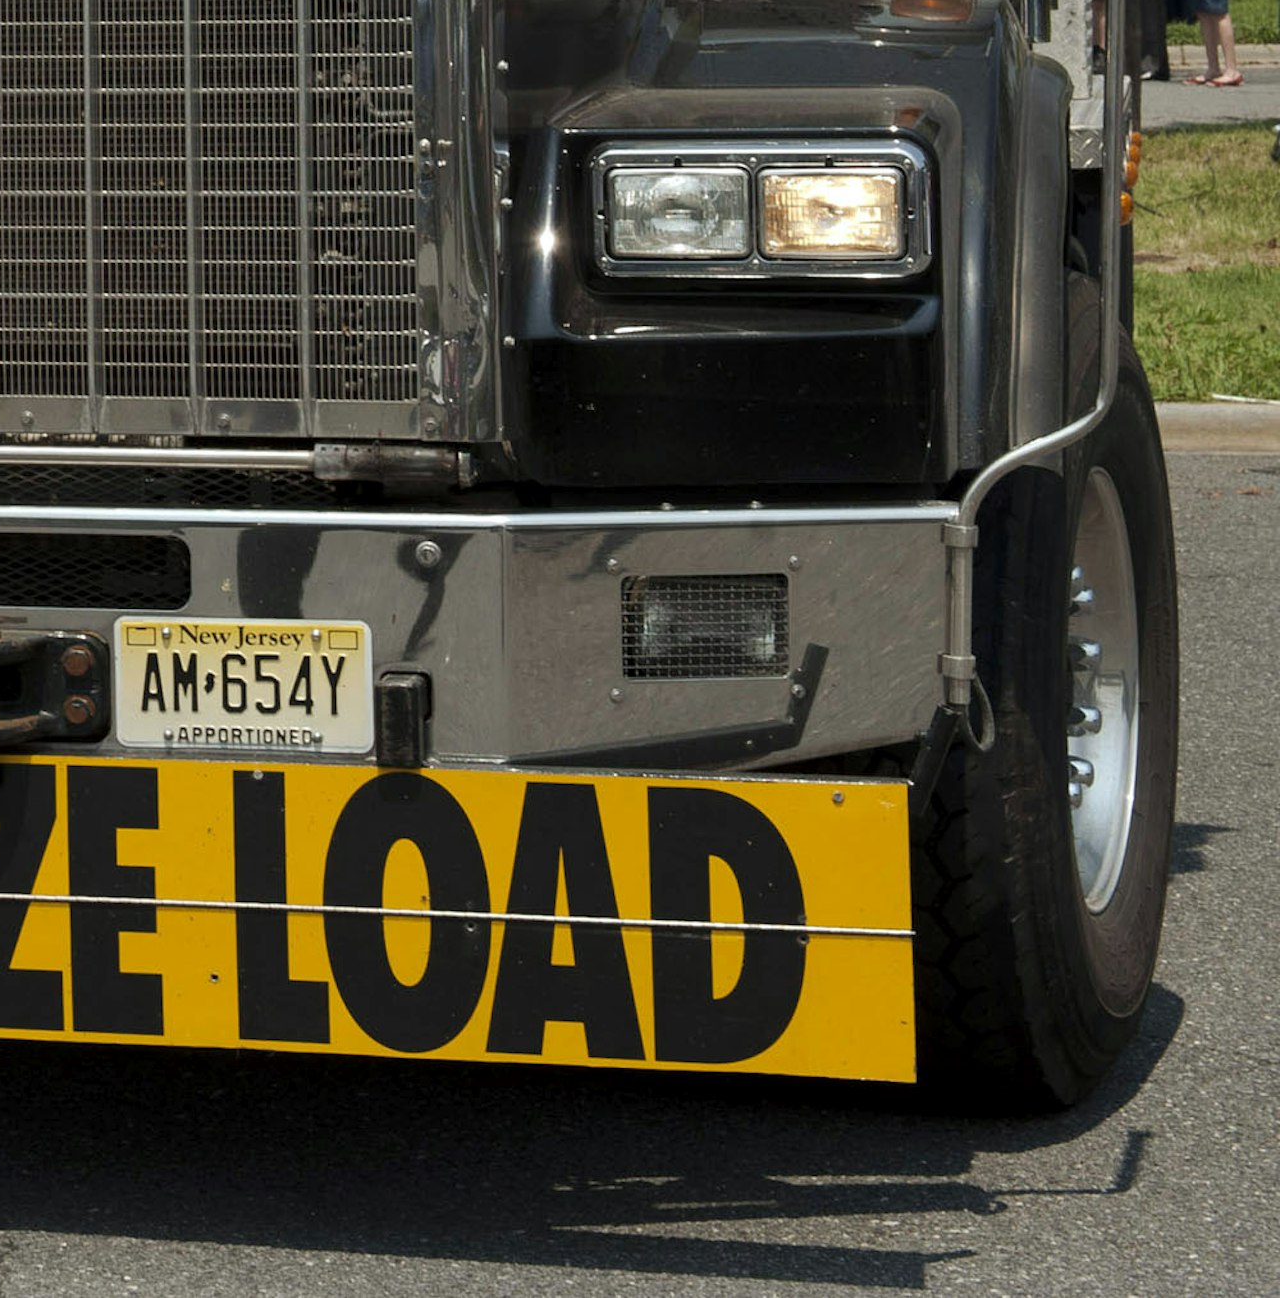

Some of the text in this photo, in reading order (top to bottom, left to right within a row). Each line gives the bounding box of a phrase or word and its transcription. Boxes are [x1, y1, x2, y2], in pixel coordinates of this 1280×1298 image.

[178, 624, 306, 652] New Jersey
[177, 726, 314, 746] APPORTIONED
[231, 769, 807, 1065] LOAD
